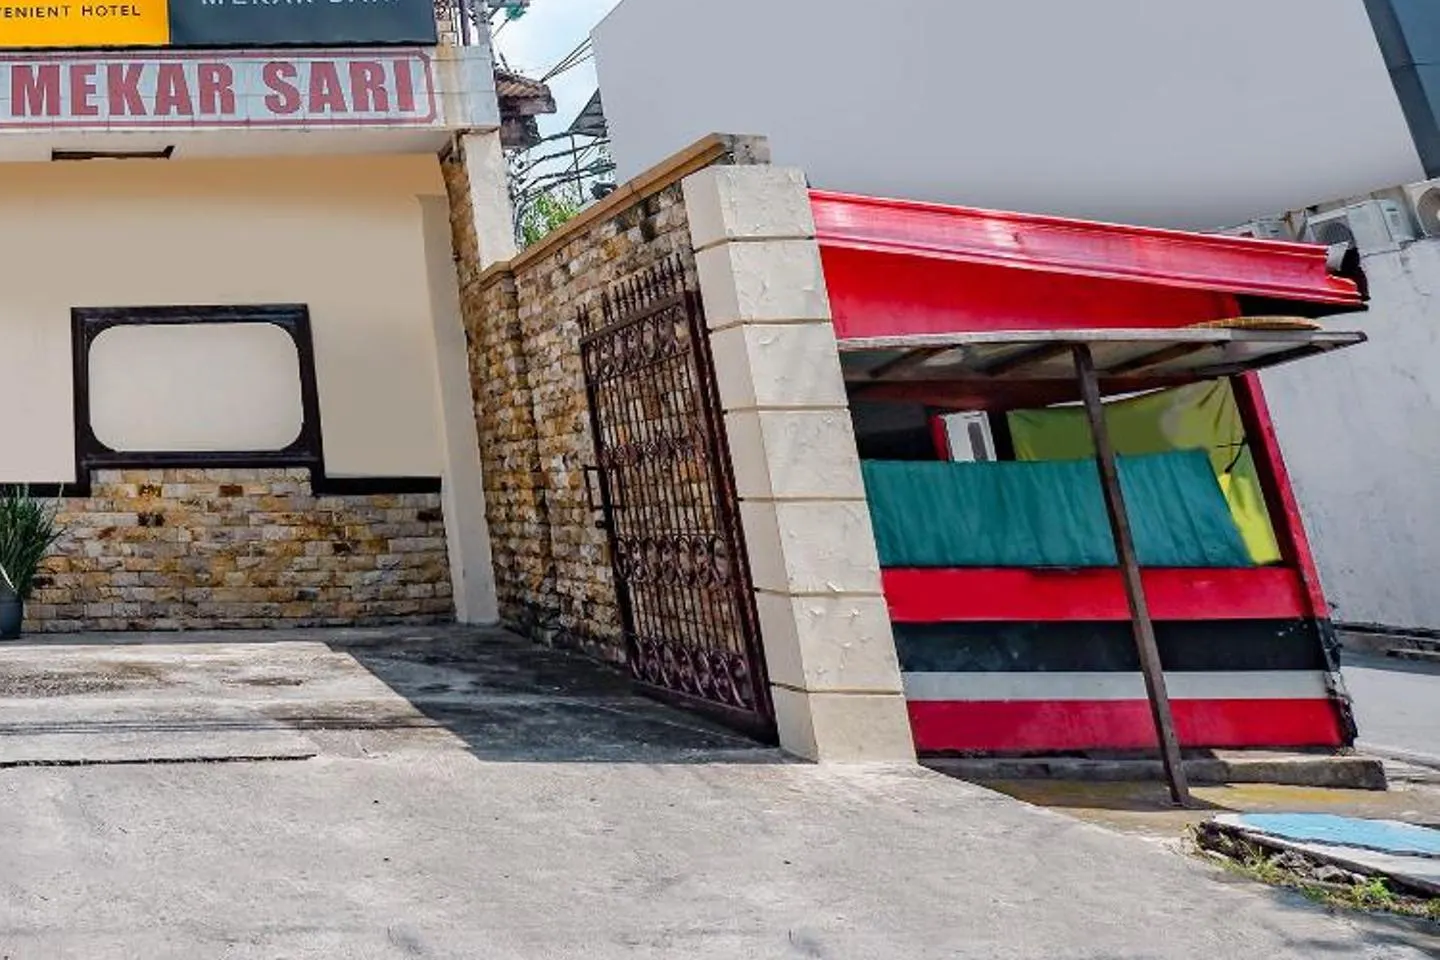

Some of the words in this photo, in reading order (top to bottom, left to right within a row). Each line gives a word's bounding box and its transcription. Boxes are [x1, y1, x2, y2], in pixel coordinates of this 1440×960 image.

[81, 3, 142, 17] HOTEL
[11, 62, 236, 117] MEKAR
[264, 59, 416, 116] SARI
